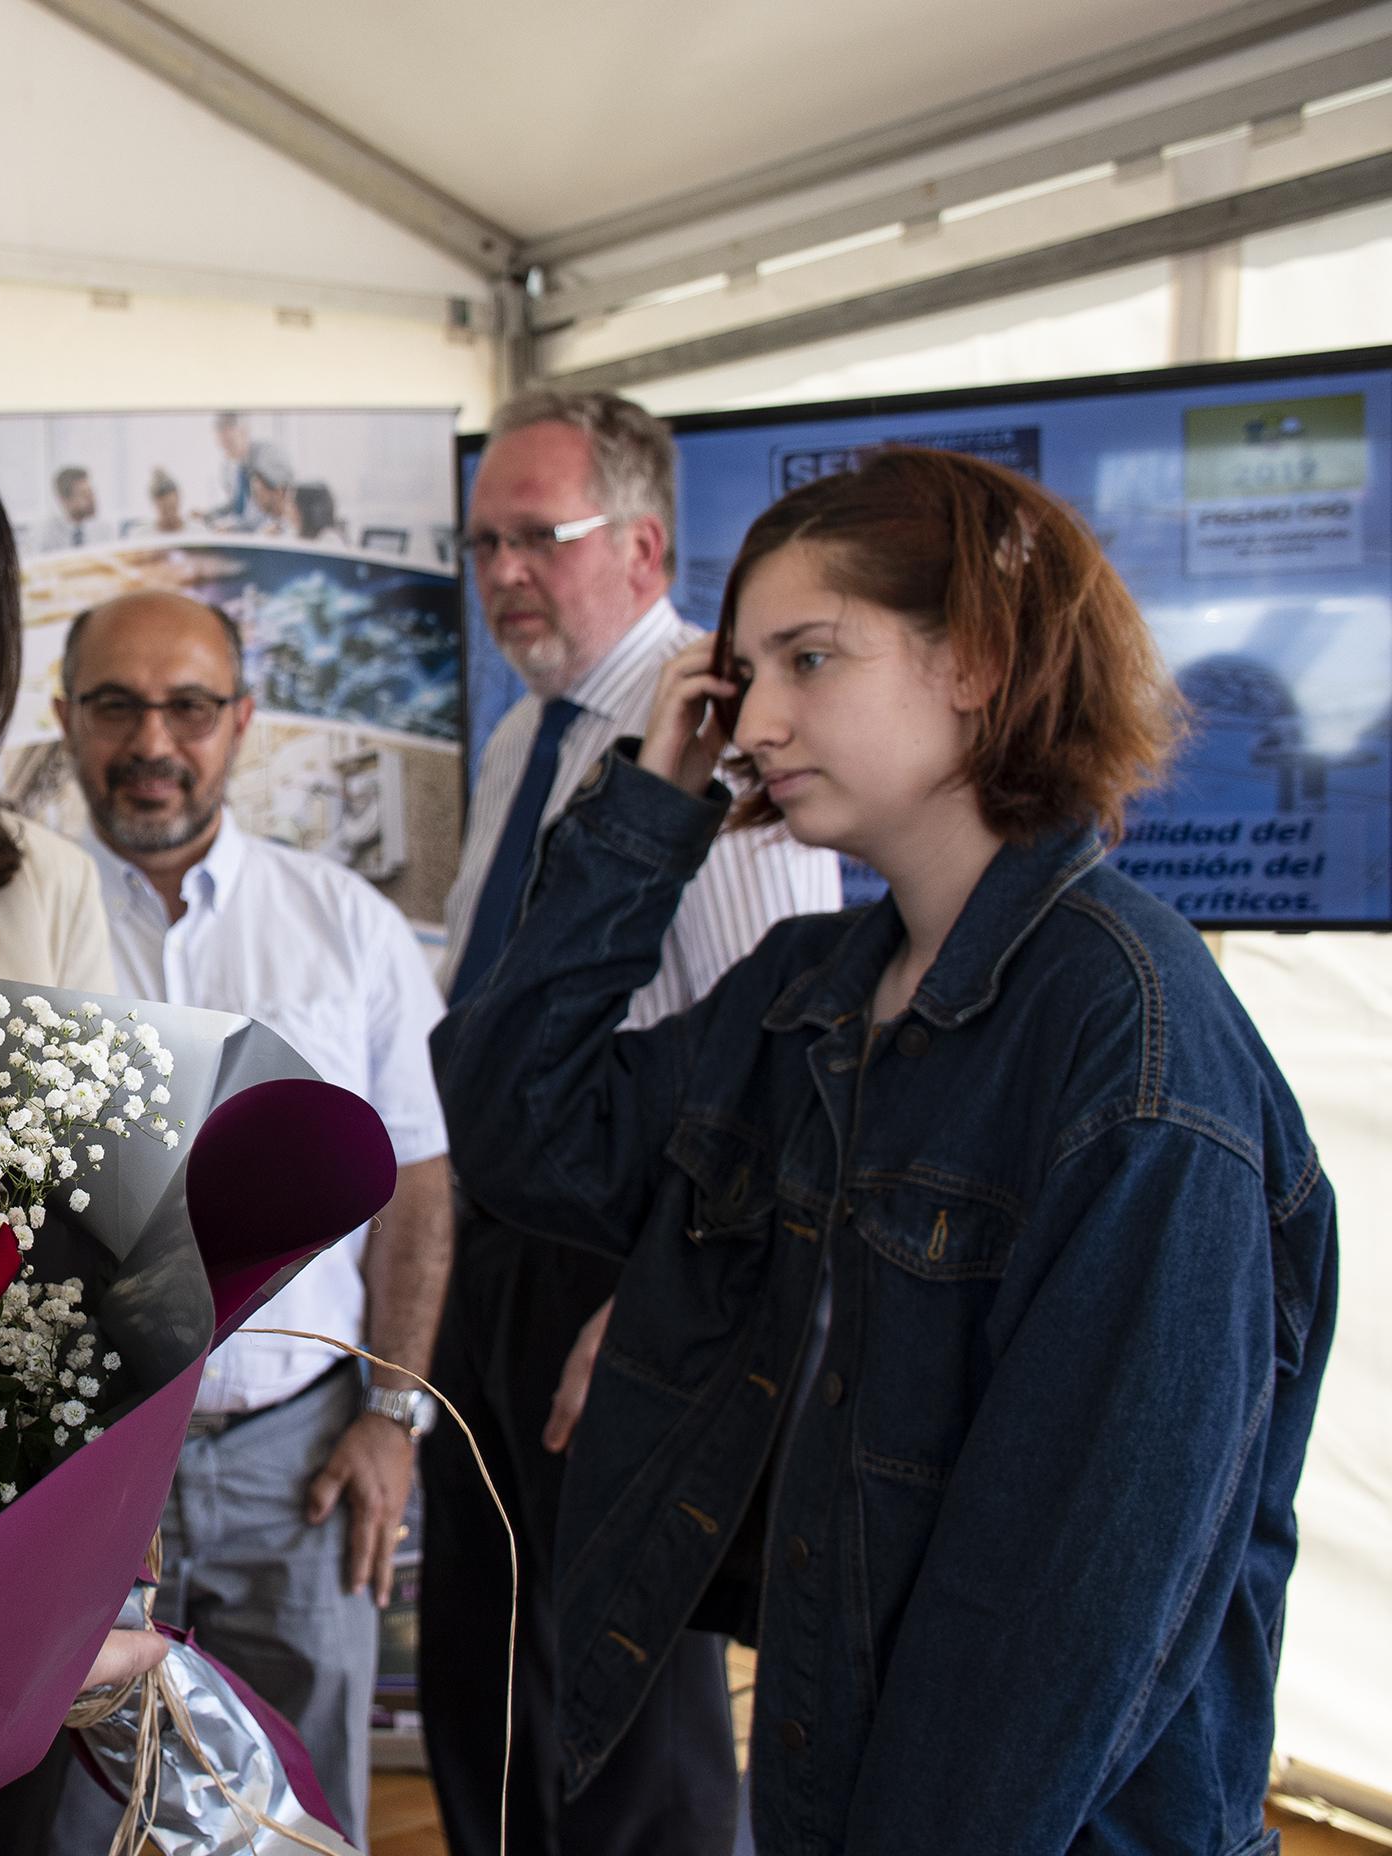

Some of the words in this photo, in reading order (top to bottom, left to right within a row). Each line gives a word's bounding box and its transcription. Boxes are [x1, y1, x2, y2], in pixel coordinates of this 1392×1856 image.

[1251, 818, 1313, 846] del
[1117, 853, 1253, 880] tensión
[1263, 852, 1326, 879] del
